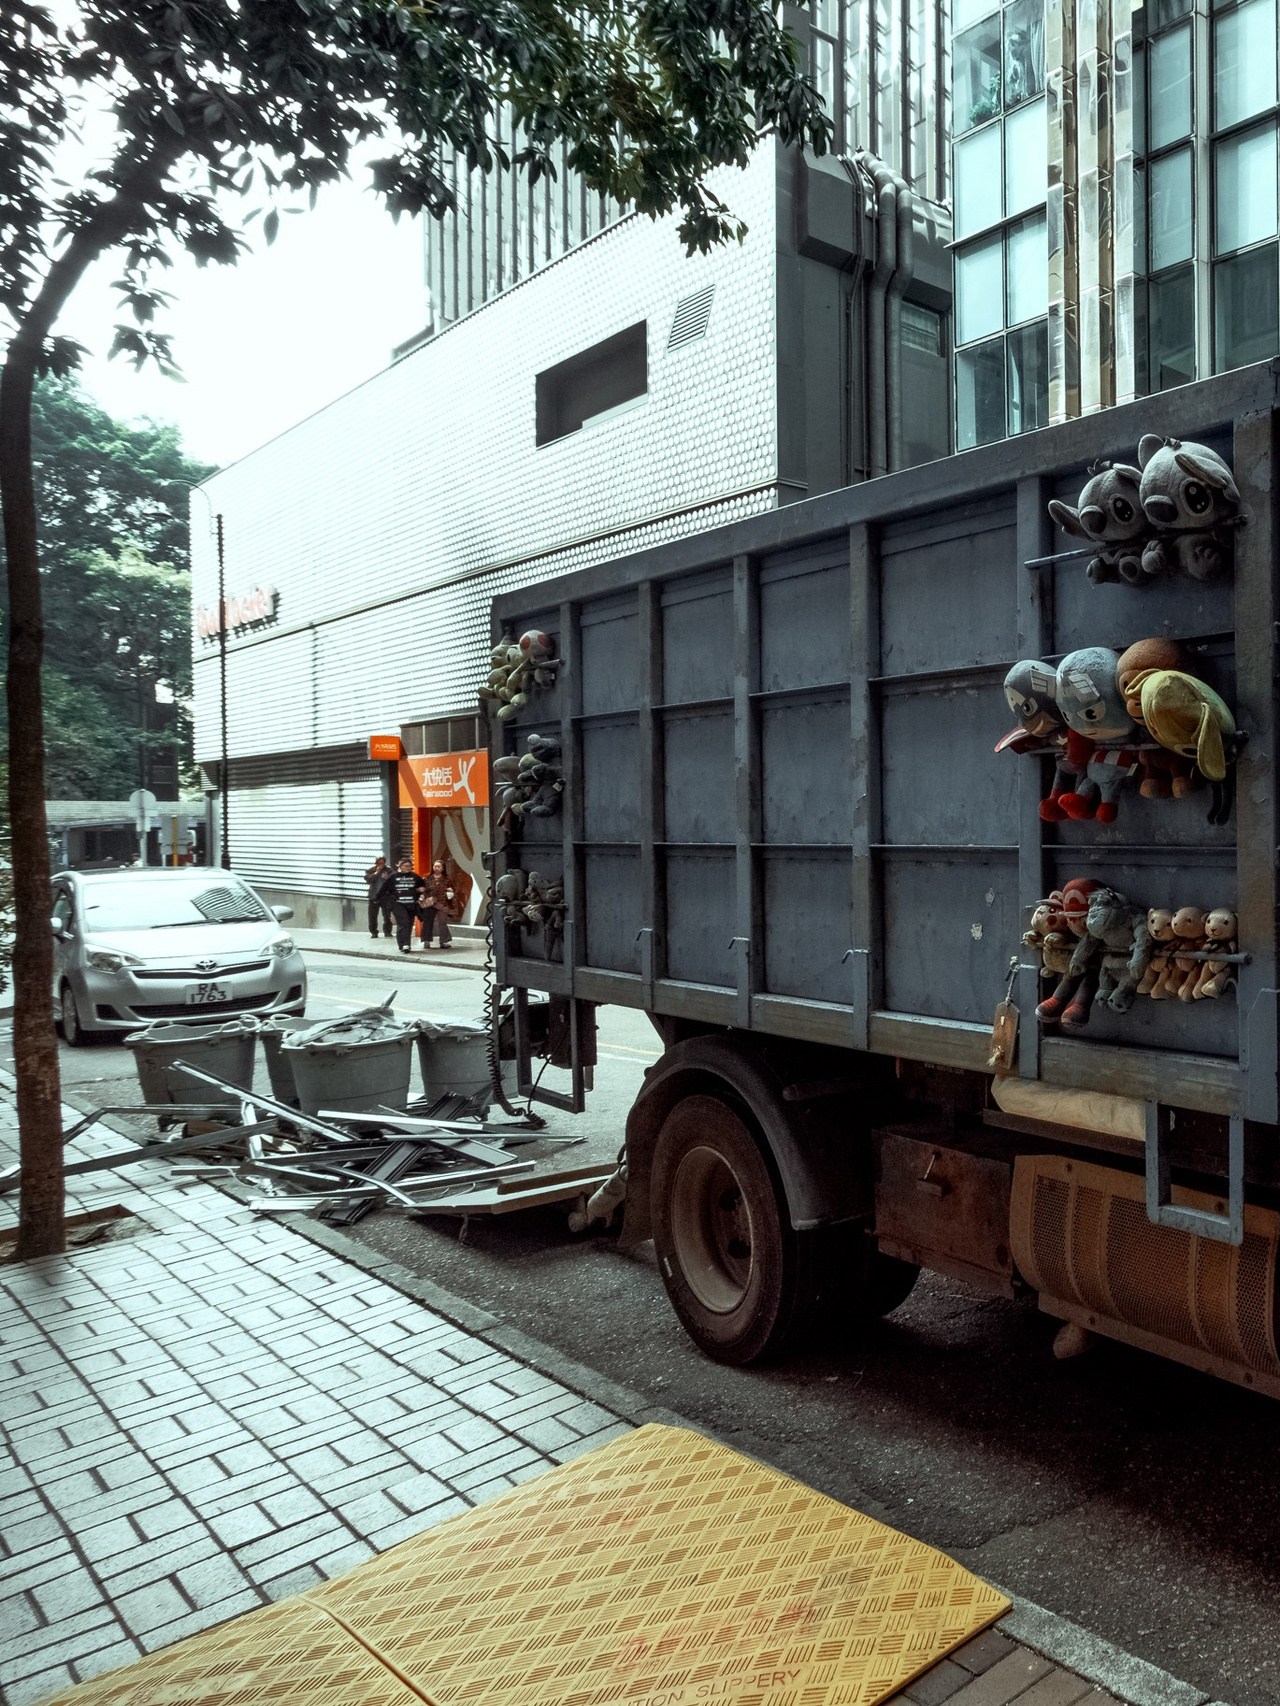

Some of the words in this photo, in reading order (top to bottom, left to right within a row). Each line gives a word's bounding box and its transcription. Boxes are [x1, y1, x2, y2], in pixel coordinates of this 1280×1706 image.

[422, 766, 452, 786] 大快活
[198, 983, 219, 993] RA
[190, 991, 227, 1003] 1763
[696, 1669, 801, 1697] SLIPPERY
